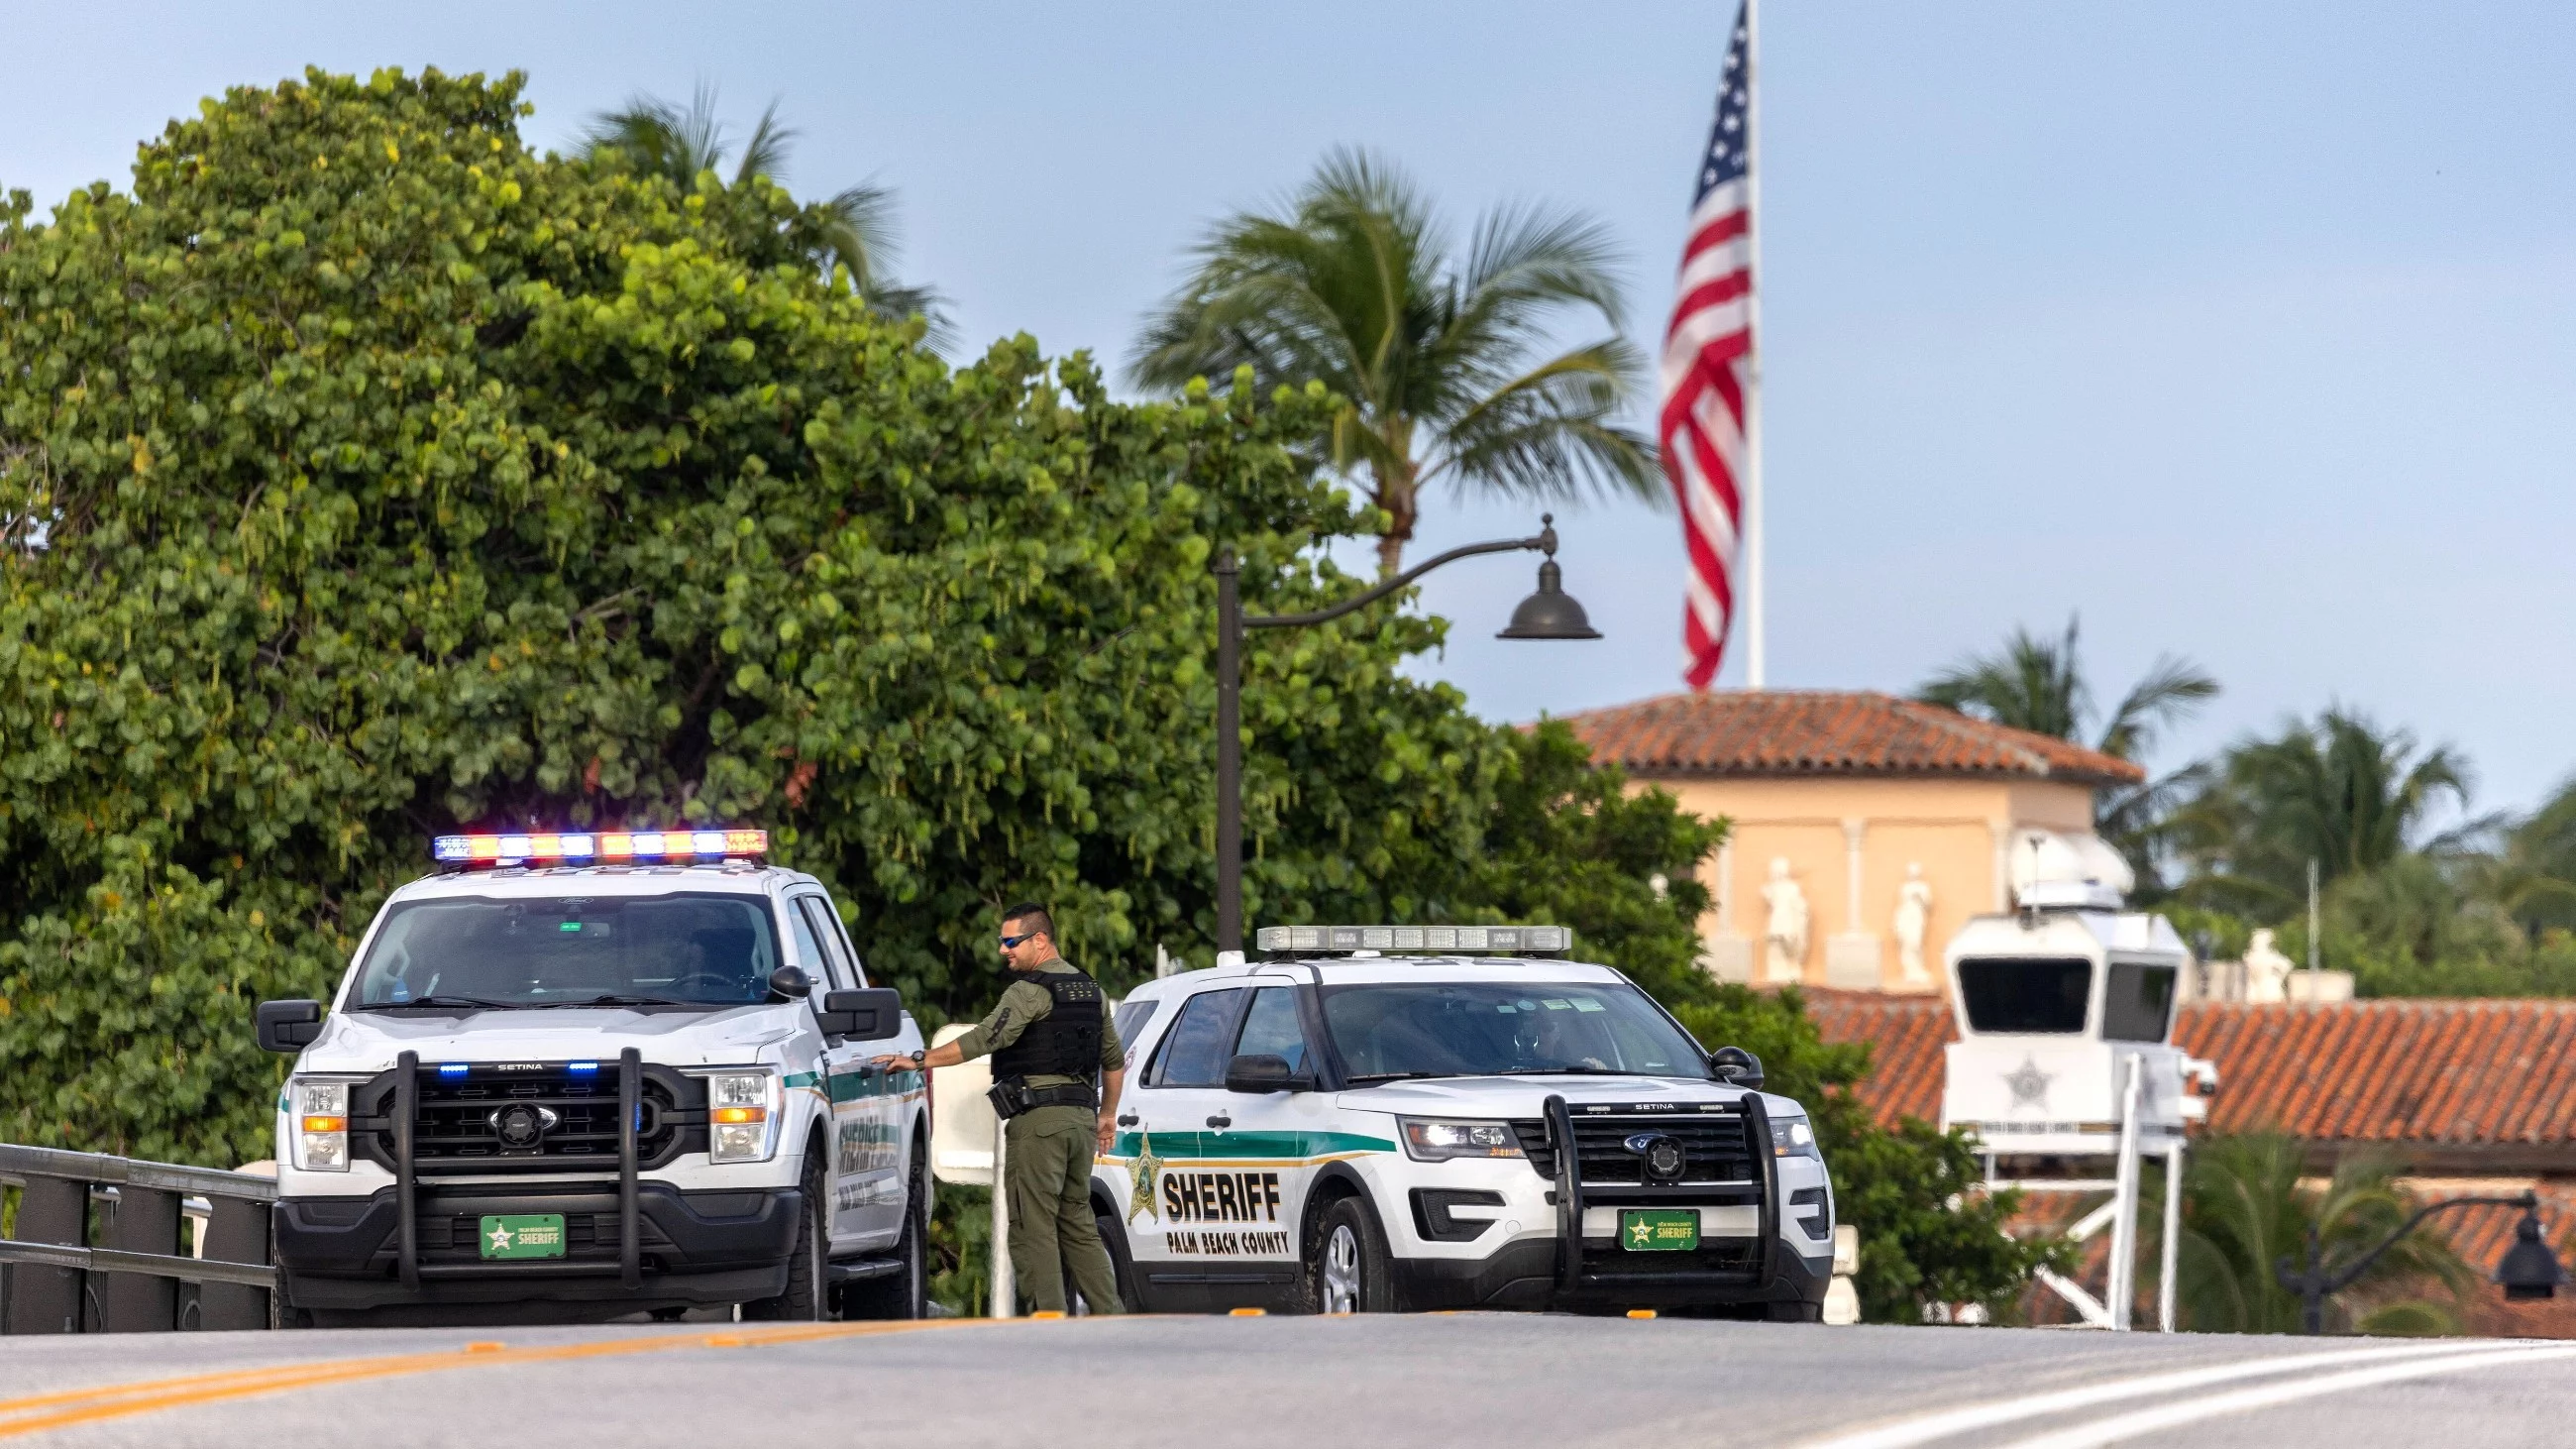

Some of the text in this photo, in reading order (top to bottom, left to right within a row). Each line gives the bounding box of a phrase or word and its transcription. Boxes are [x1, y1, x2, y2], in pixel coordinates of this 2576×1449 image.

[1163, 1172, 1281, 1223] SHERIFF
[518, 1232, 559, 1245] SHERIFF
[1657, 1228, 1693, 1239] SHERIFF
[1166, 1231, 1289, 1255] PALM BEACH COUNTY
